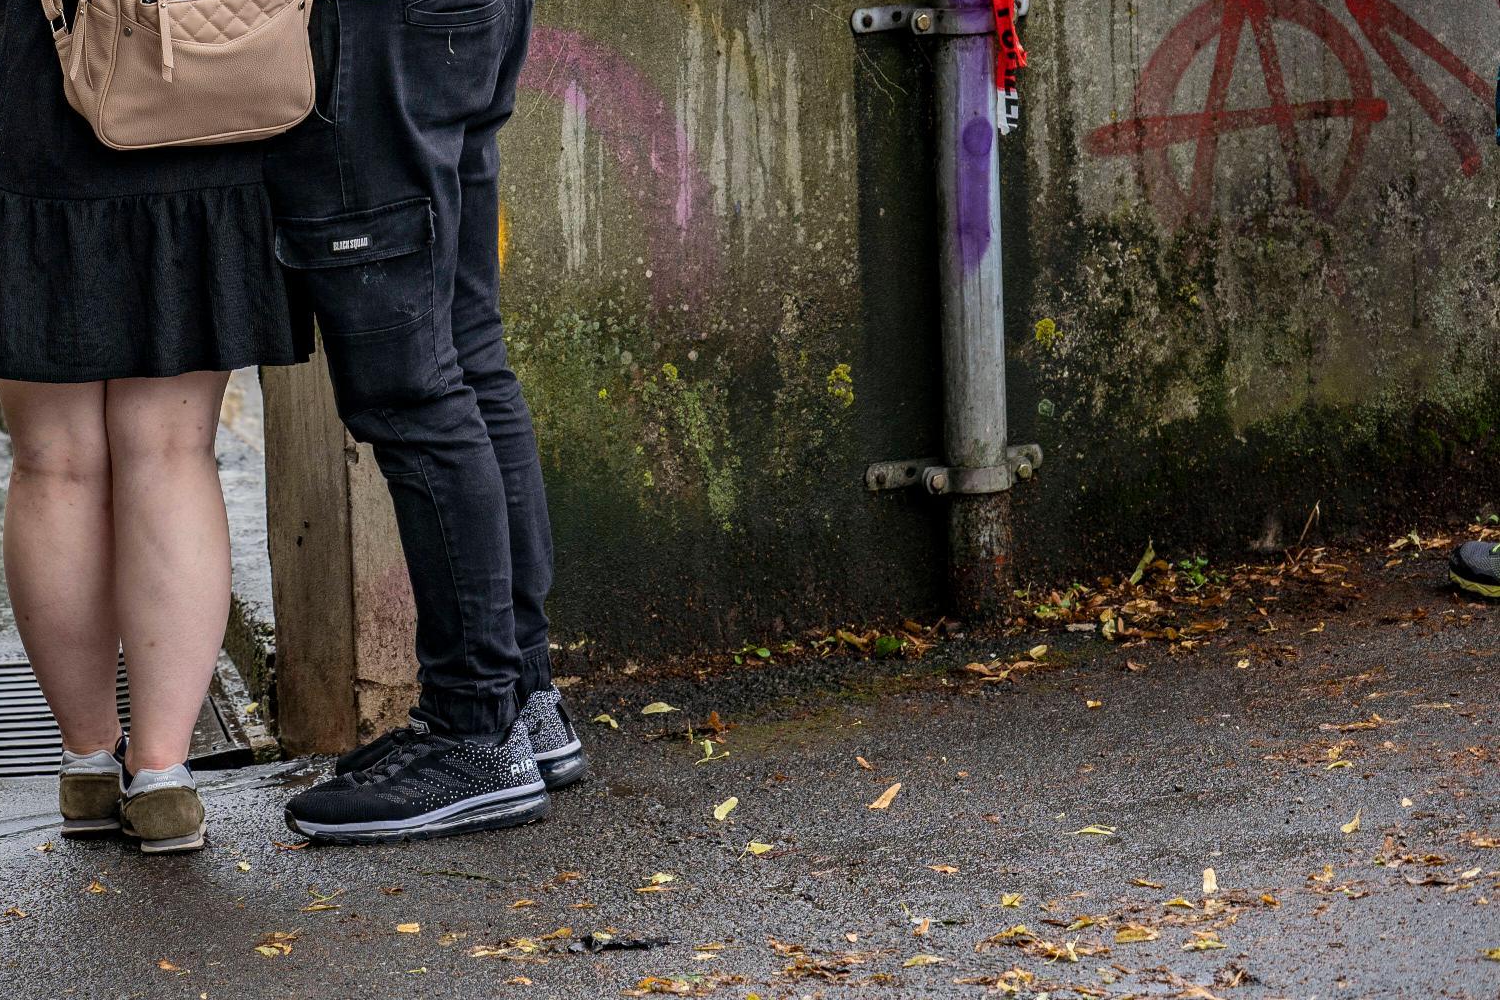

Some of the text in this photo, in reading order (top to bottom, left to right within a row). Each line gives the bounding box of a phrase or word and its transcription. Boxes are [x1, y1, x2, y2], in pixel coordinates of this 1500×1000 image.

[350, 237, 368, 250] SQUAD
[510, 758, 534, 777] AIR
[147, 780, 178, 790] balance
